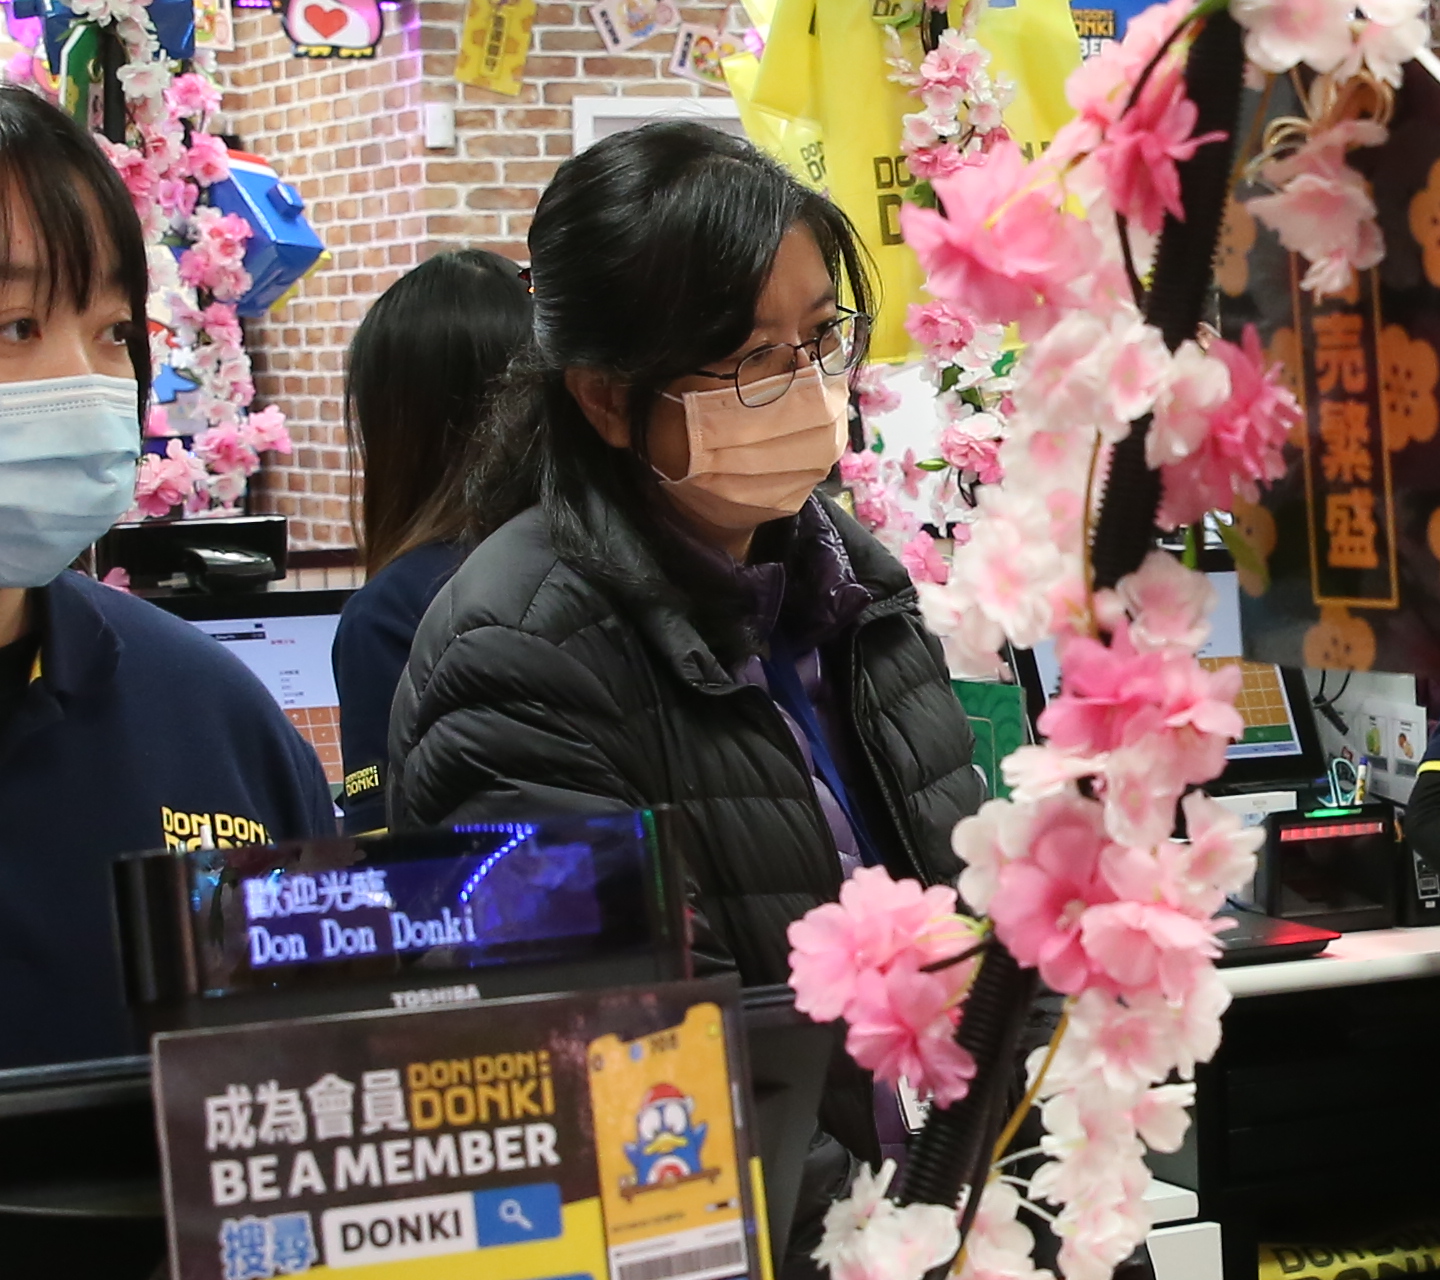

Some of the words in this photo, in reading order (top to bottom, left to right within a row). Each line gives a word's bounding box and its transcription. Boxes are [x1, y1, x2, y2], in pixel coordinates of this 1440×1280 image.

[1312, 310, 1380, 570] 売繁盛
[249, 928, 307, 969] Don
[322, 918, 379, 959] Don
[391, 906, 477, 953] Donki
[390, 984, 481, 1009] TOSHIBA
[204, 1070, 410, 1152] 成為會員
[410, 1075, 556, 1130] DONKI
[210, 1155, 282, 1207] BE
[287, 1151, 328, 1197] A
[333, 1121, 561, 1190] MEMBER
[340, 1206, 464, 1254] DONKI
